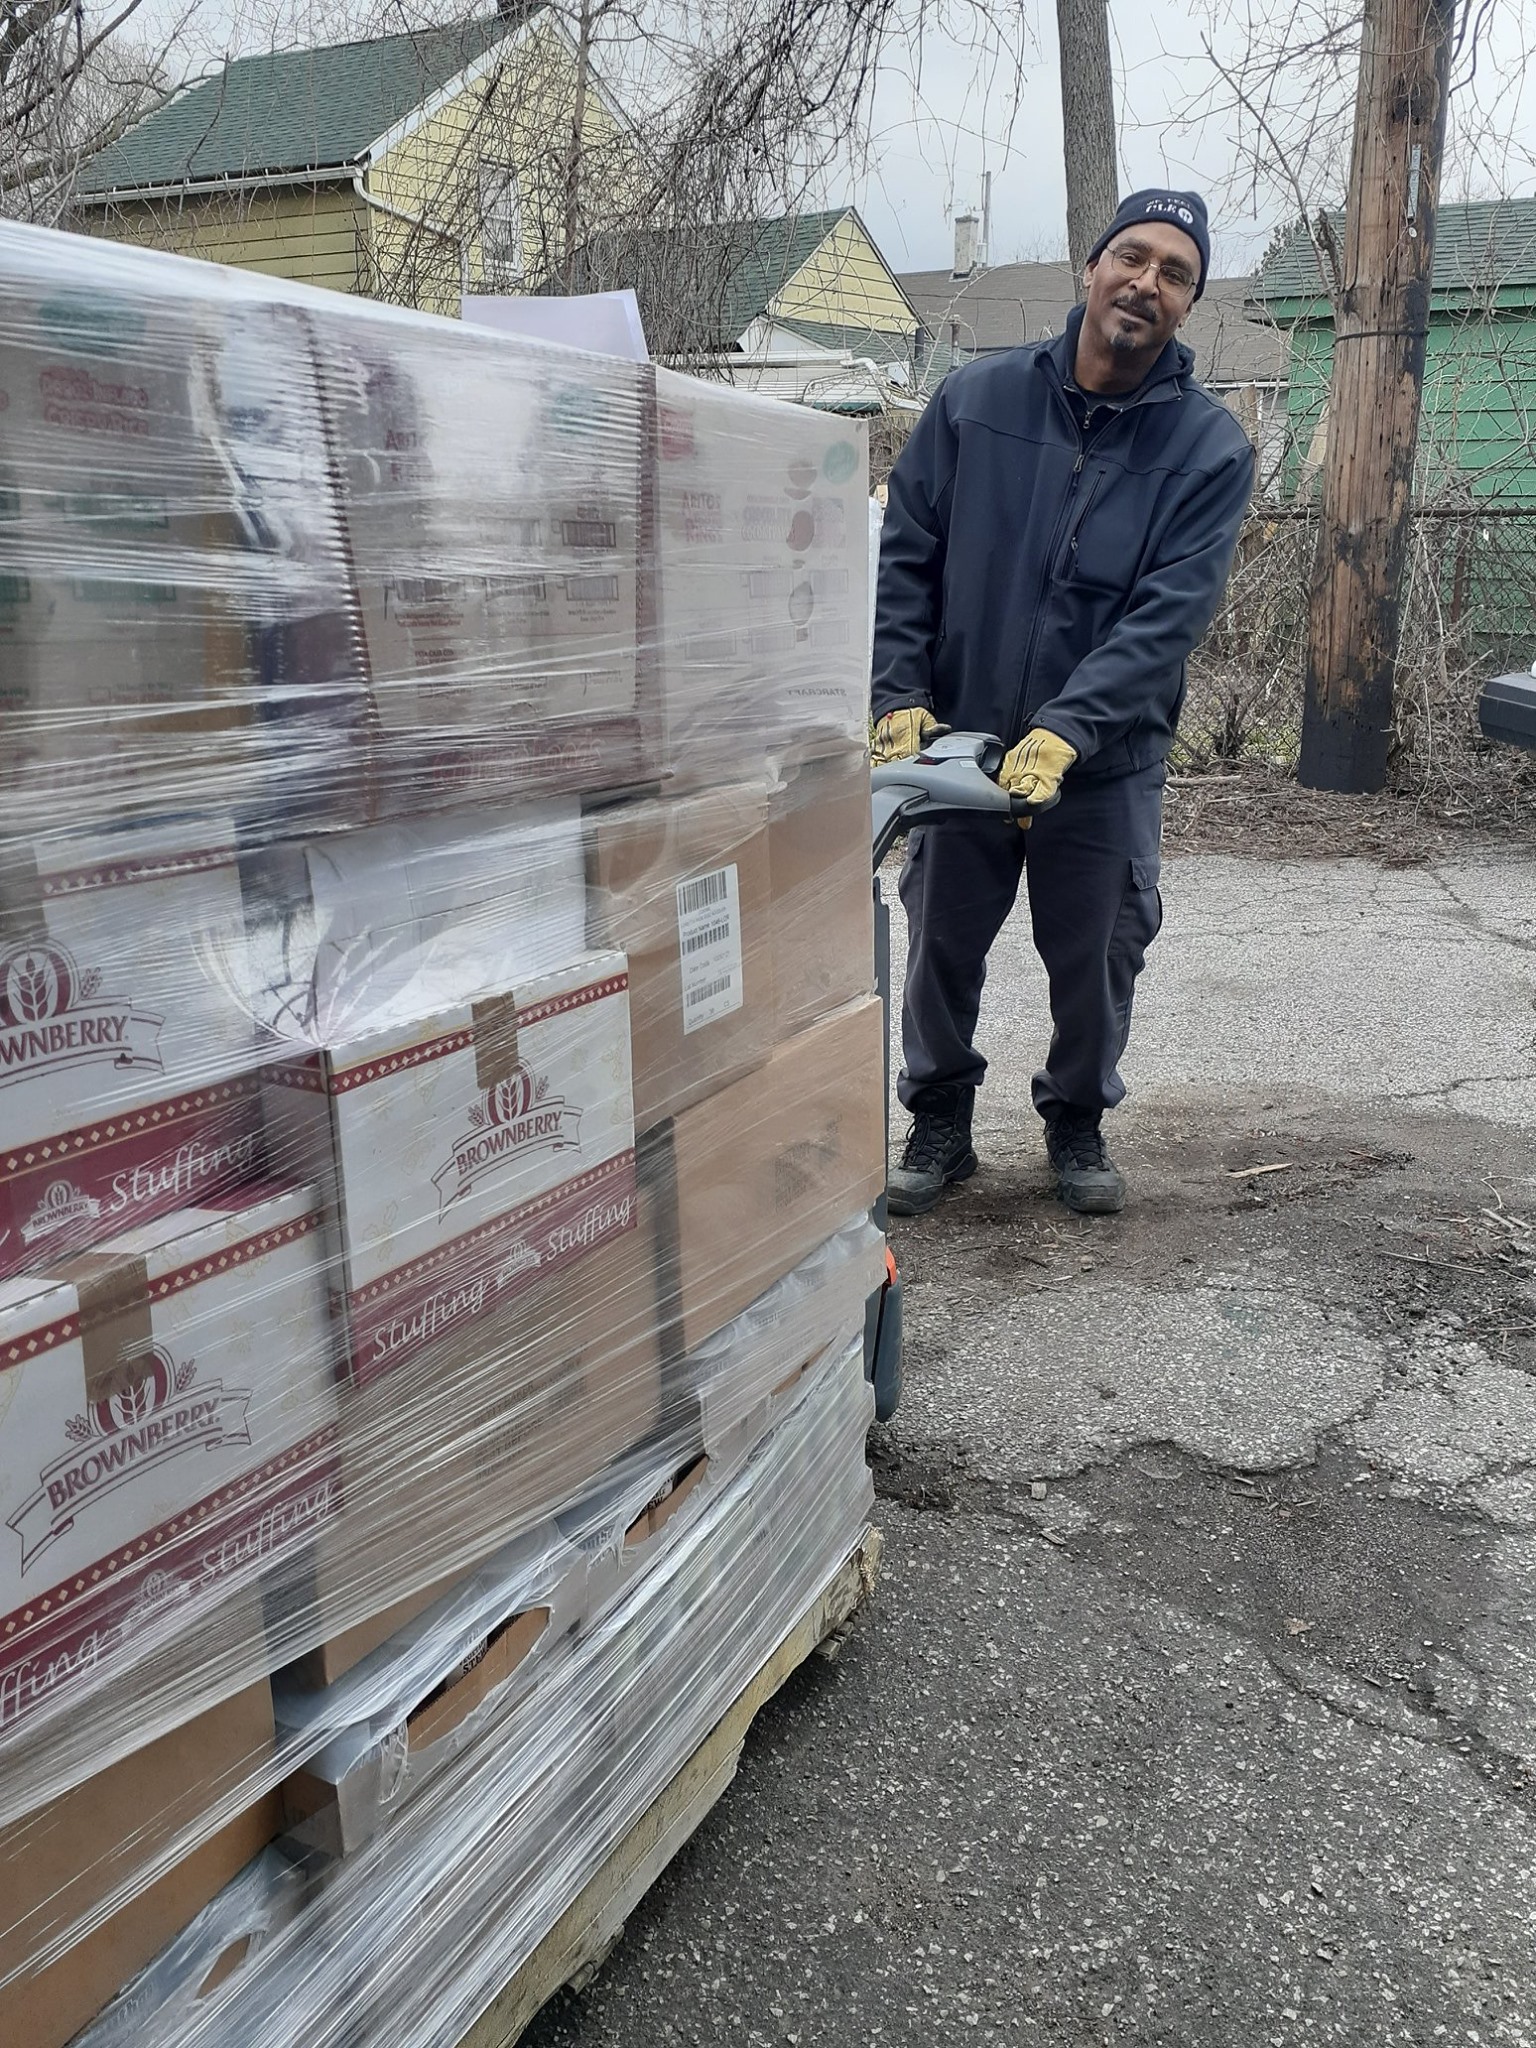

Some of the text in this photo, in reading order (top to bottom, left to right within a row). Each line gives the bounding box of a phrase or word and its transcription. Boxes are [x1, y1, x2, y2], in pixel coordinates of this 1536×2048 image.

[110, 1135, 258, 1212] Stuffing
[455, 1110, 563, 1176] BROWNBERRY
[372, 1193, 638, 1362] Stuffing Stuffing
[46, 1400, 221, 1511] BROWNBERRY
[200, 1480, 339, 1588] Stuffing
